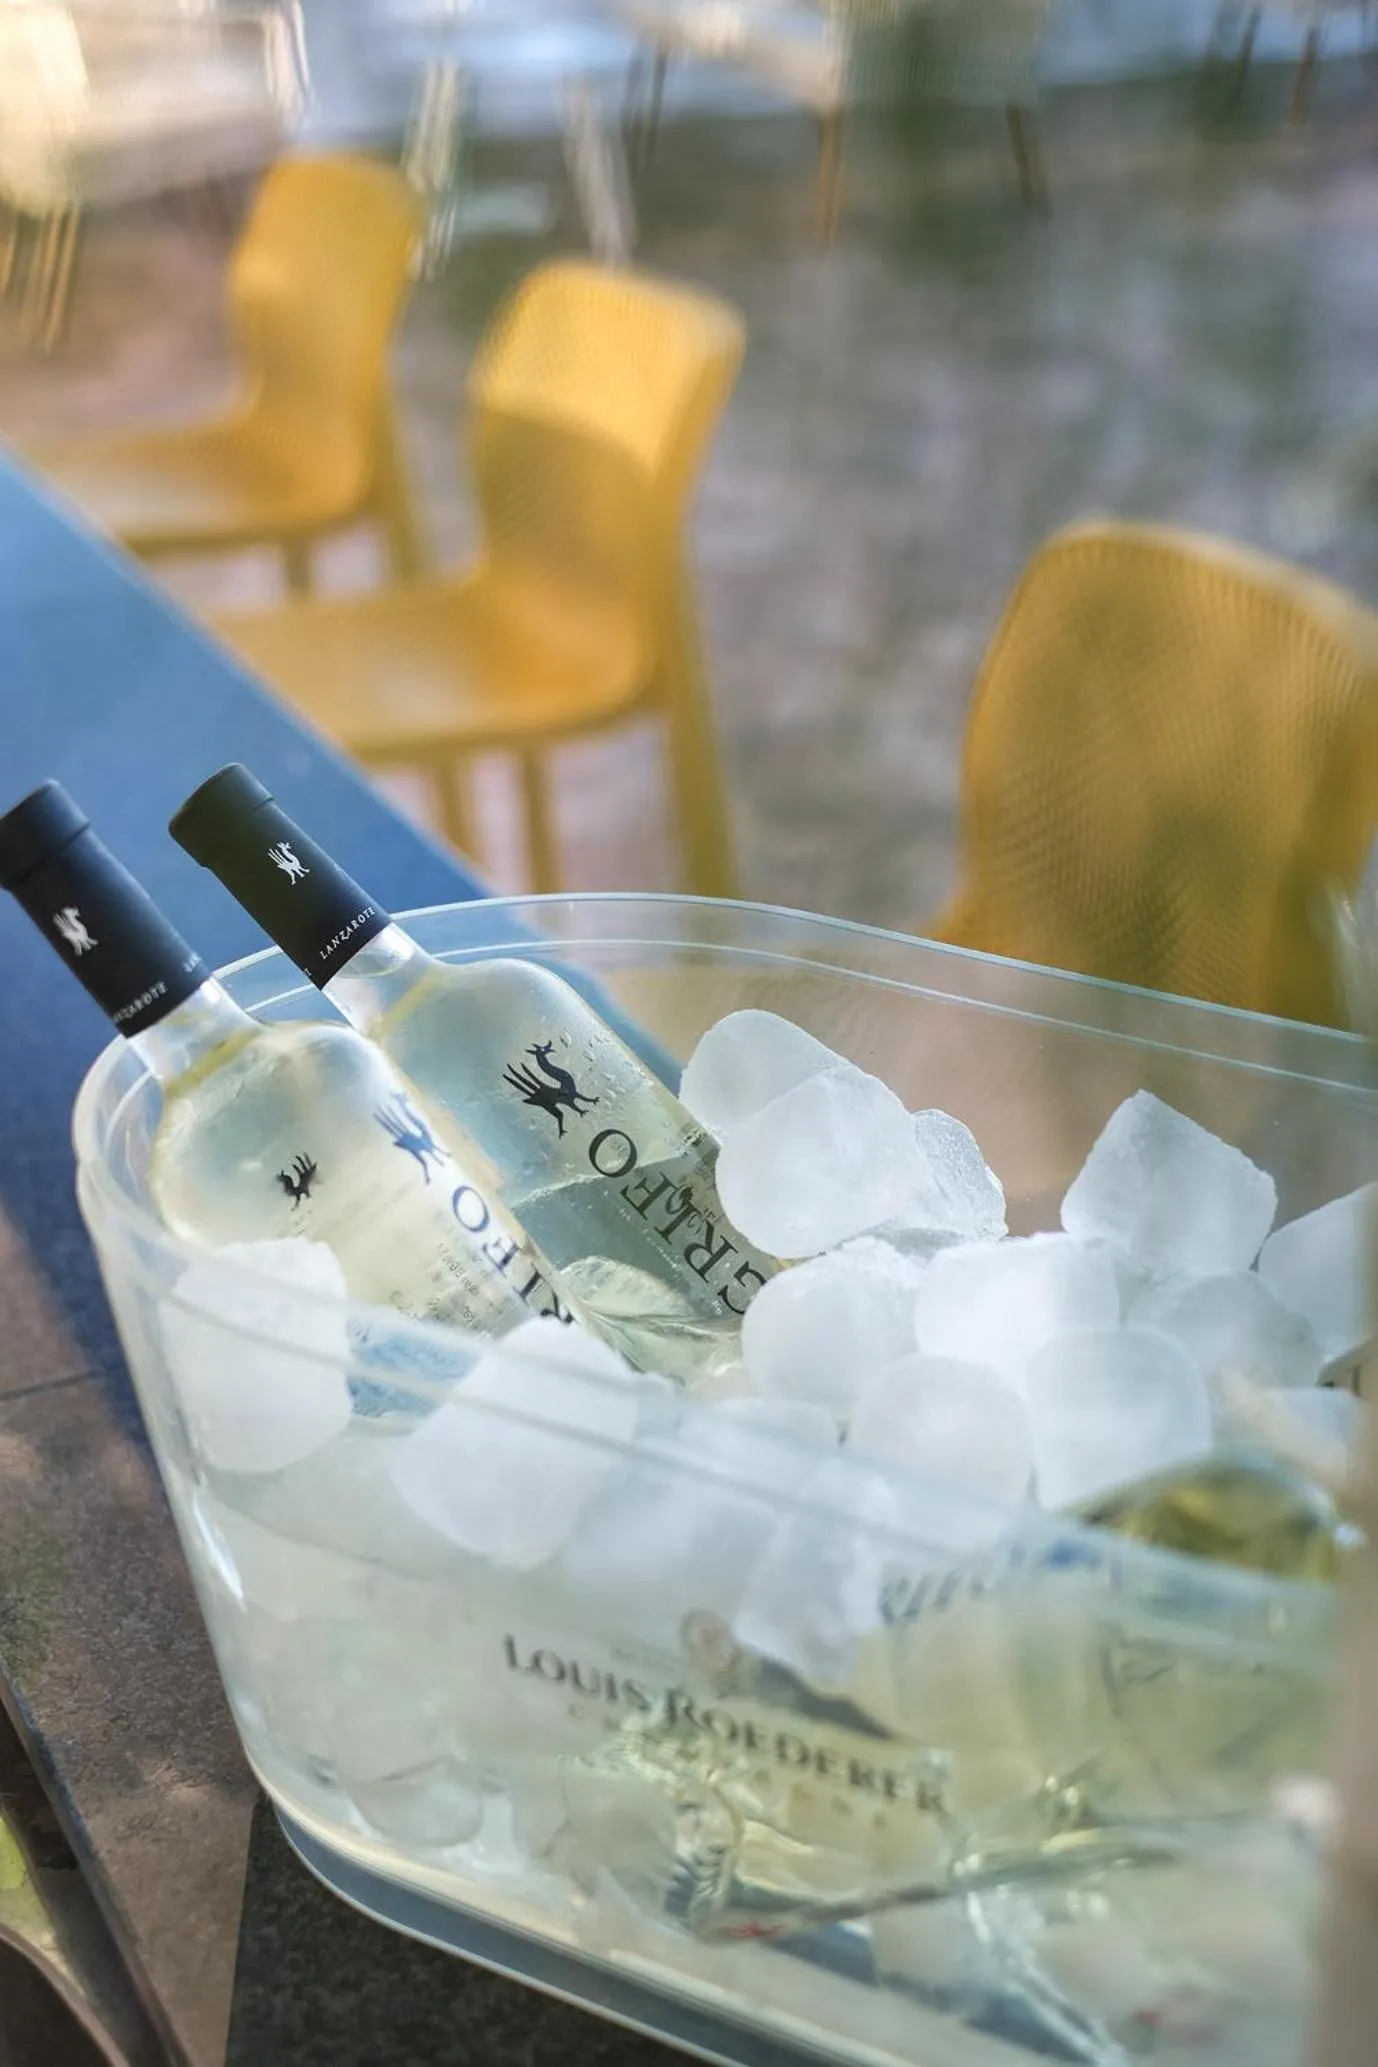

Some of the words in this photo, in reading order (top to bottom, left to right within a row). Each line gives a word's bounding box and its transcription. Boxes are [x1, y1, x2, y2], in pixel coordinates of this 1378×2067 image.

[587, 1127, 768, 1316] GRIFO
[502, 1632, 652, 1713] LOUIS
[661, 1685, 949, 1818] ROEDERER
